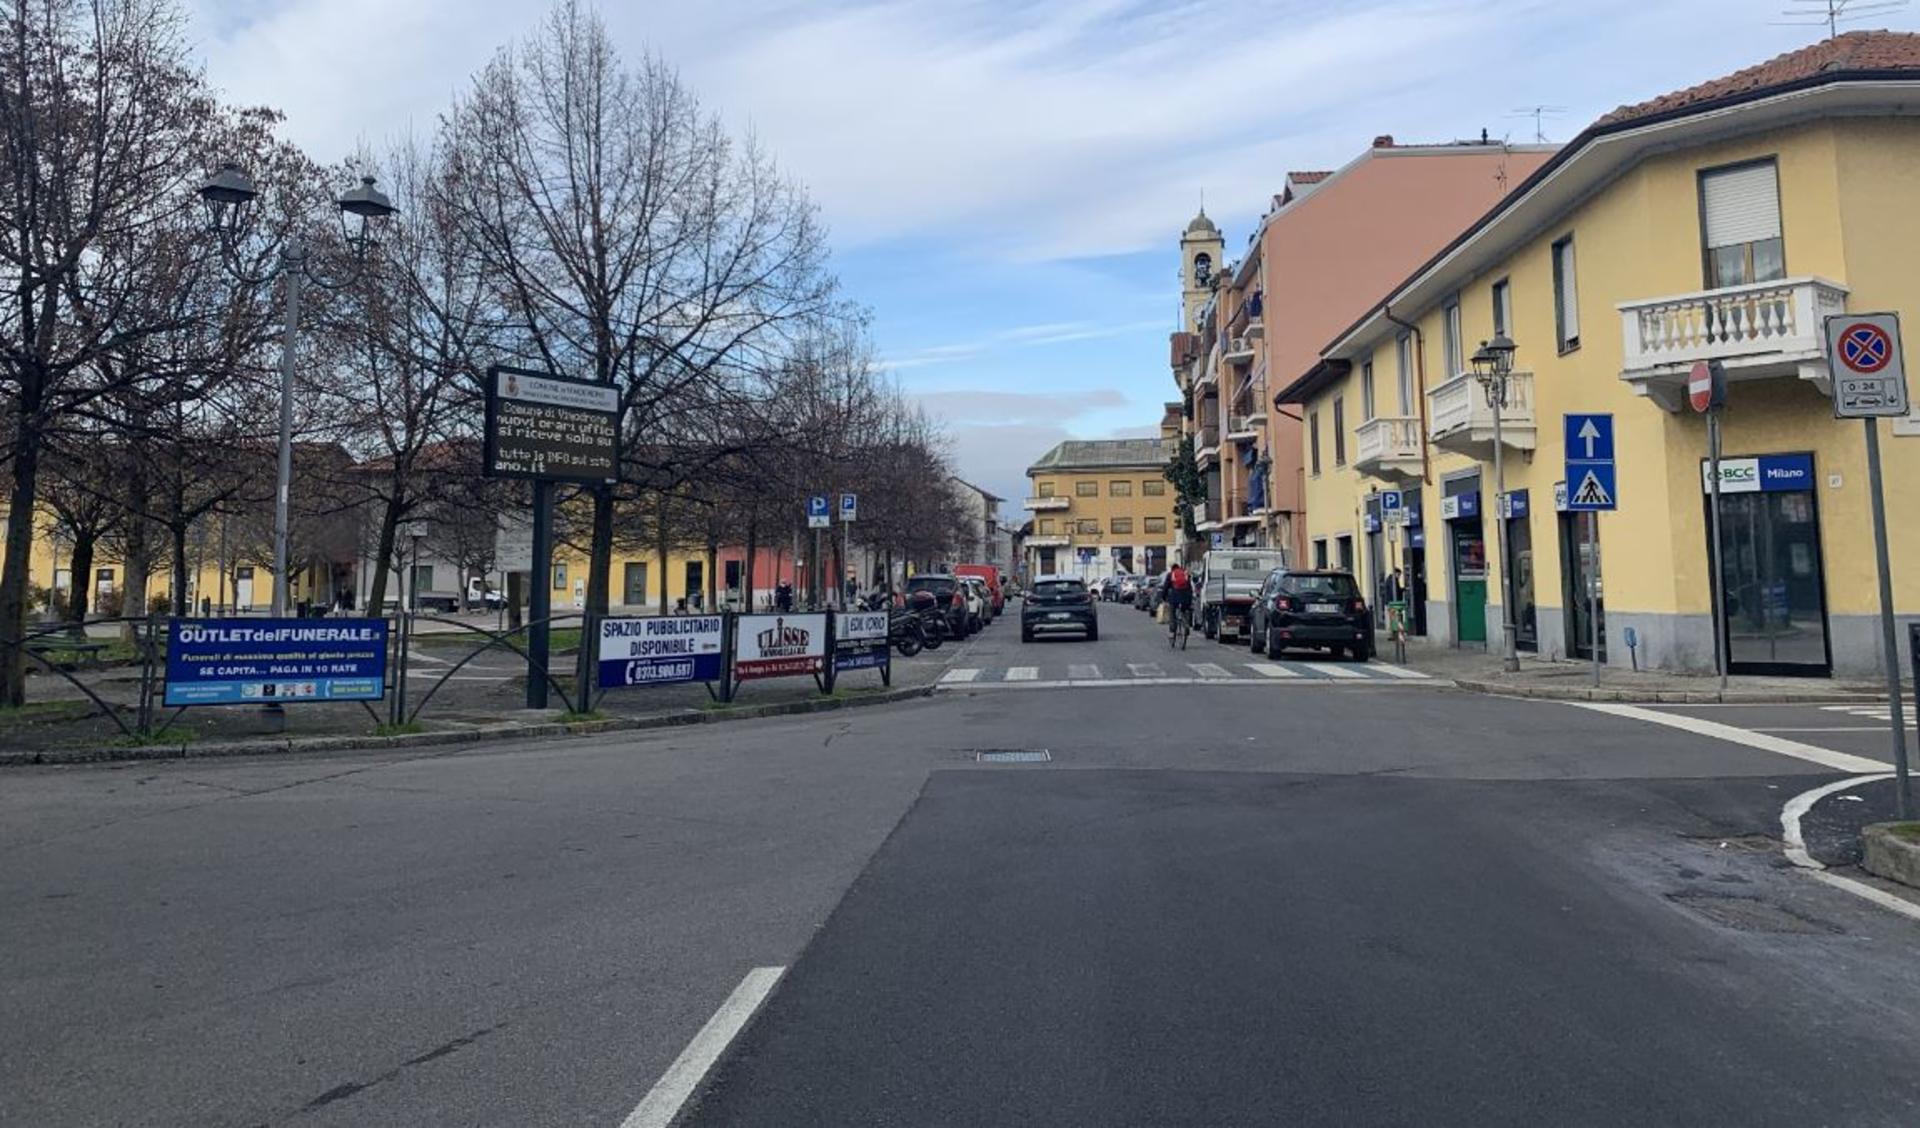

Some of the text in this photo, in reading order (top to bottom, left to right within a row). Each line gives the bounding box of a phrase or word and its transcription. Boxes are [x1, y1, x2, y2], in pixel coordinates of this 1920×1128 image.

[1849, 383, 1855, 391] 0
[1862, 382, 1875, 390] 24
[545, 408, 555, 418] di
[496, 415, 535, 428] nuovi
[539, 420, 576, 431] orari
[499, 426, 612, 447] si riceve solo su
[1723, 467, 1804, 479] BCC Milano
[1386, 494, 1396, 507] P
[603, 618, 720, 638] SPAZIO PUBBLICITARIO
[757, 619, 810, 649] ULISSE
[630, 638, 695, 657] DISPONIBILE
[199, 666, 215, 676] SE
[269, 665, 298, 674] PAGA
[301, 664, 313, 673] IN
[316, 664, 328, 673] 10
[331, 663, 358, 673] RATE
